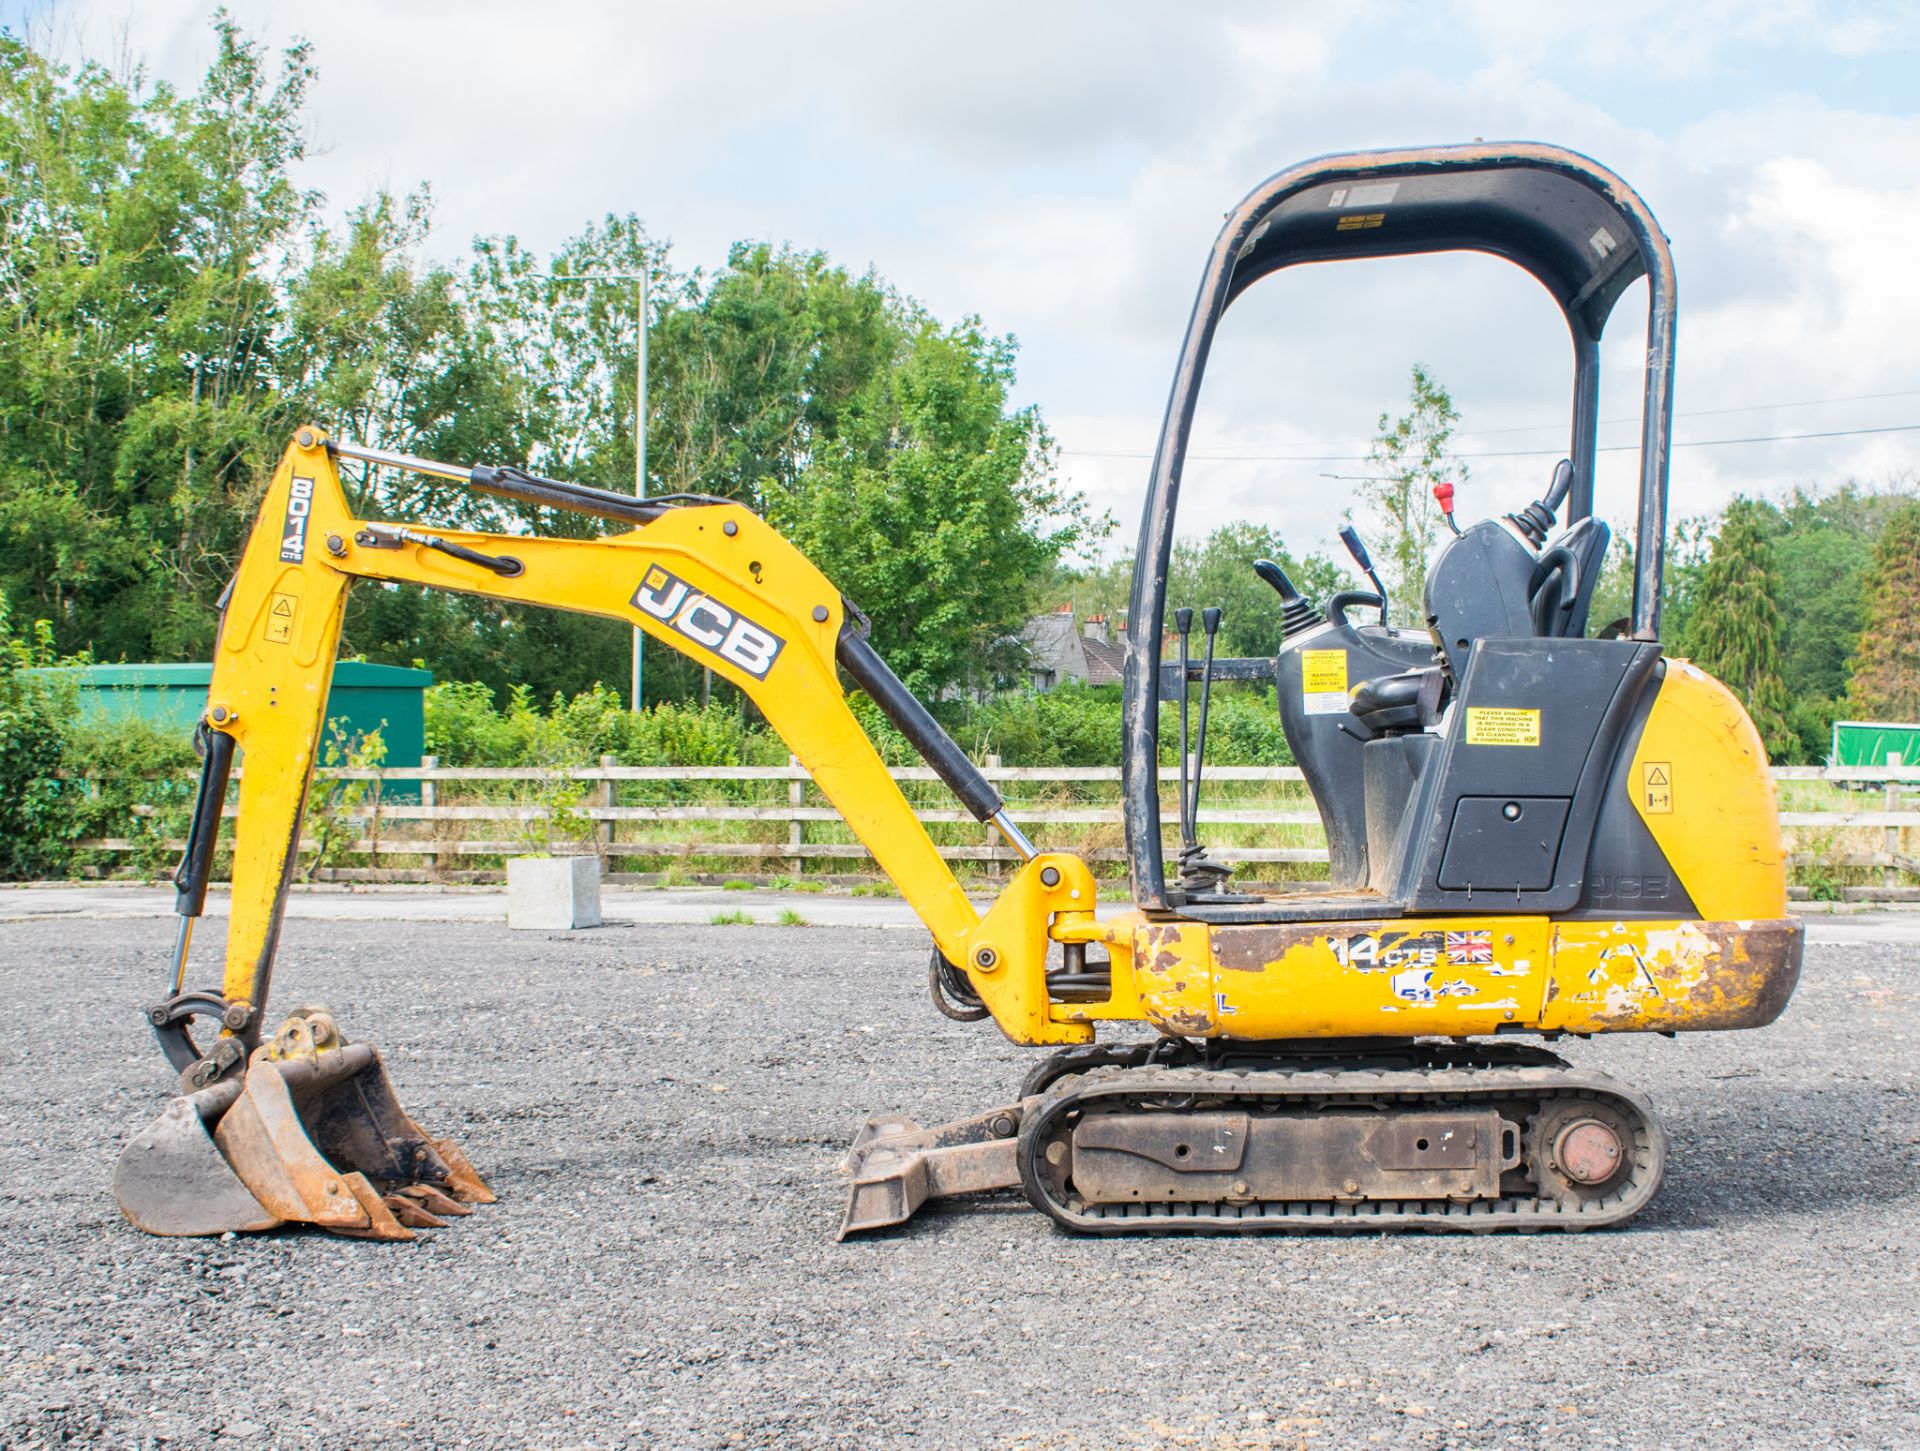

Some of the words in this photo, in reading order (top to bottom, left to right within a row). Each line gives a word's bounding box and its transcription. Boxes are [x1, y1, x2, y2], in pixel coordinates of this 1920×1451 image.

[282, 478, 313, 554] 8014
[637, 582, 778, 674] JCB
[1590, 875, 1670, 899] JCB
